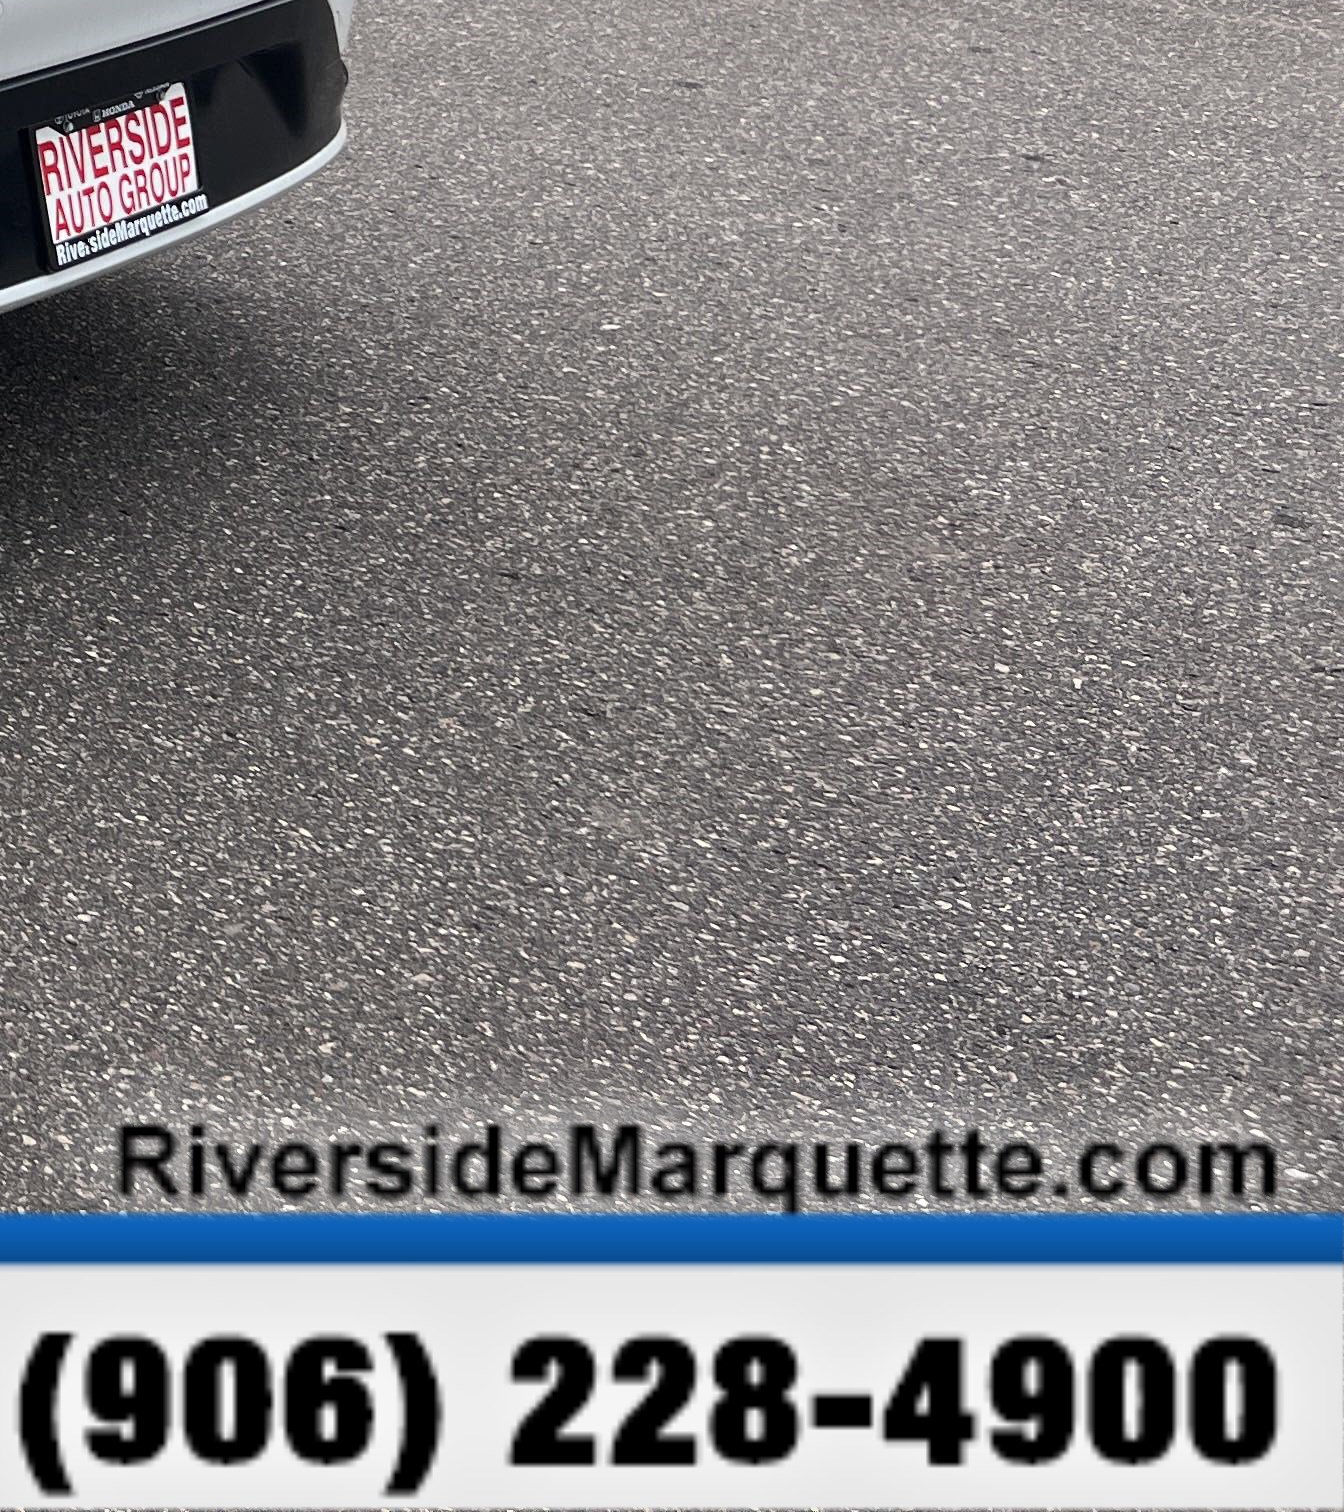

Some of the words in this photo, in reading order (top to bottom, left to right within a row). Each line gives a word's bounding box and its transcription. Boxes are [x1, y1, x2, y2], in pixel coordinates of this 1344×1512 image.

[38, 96, 191, 196] RIVERSIDE
[101, 100, 135, 118] HONDA
[55, 181, 114, 241] AUTO
[119, 153, 192, 215] GROUP
[55, 194, 209, 266] RiversideMarquette.com
